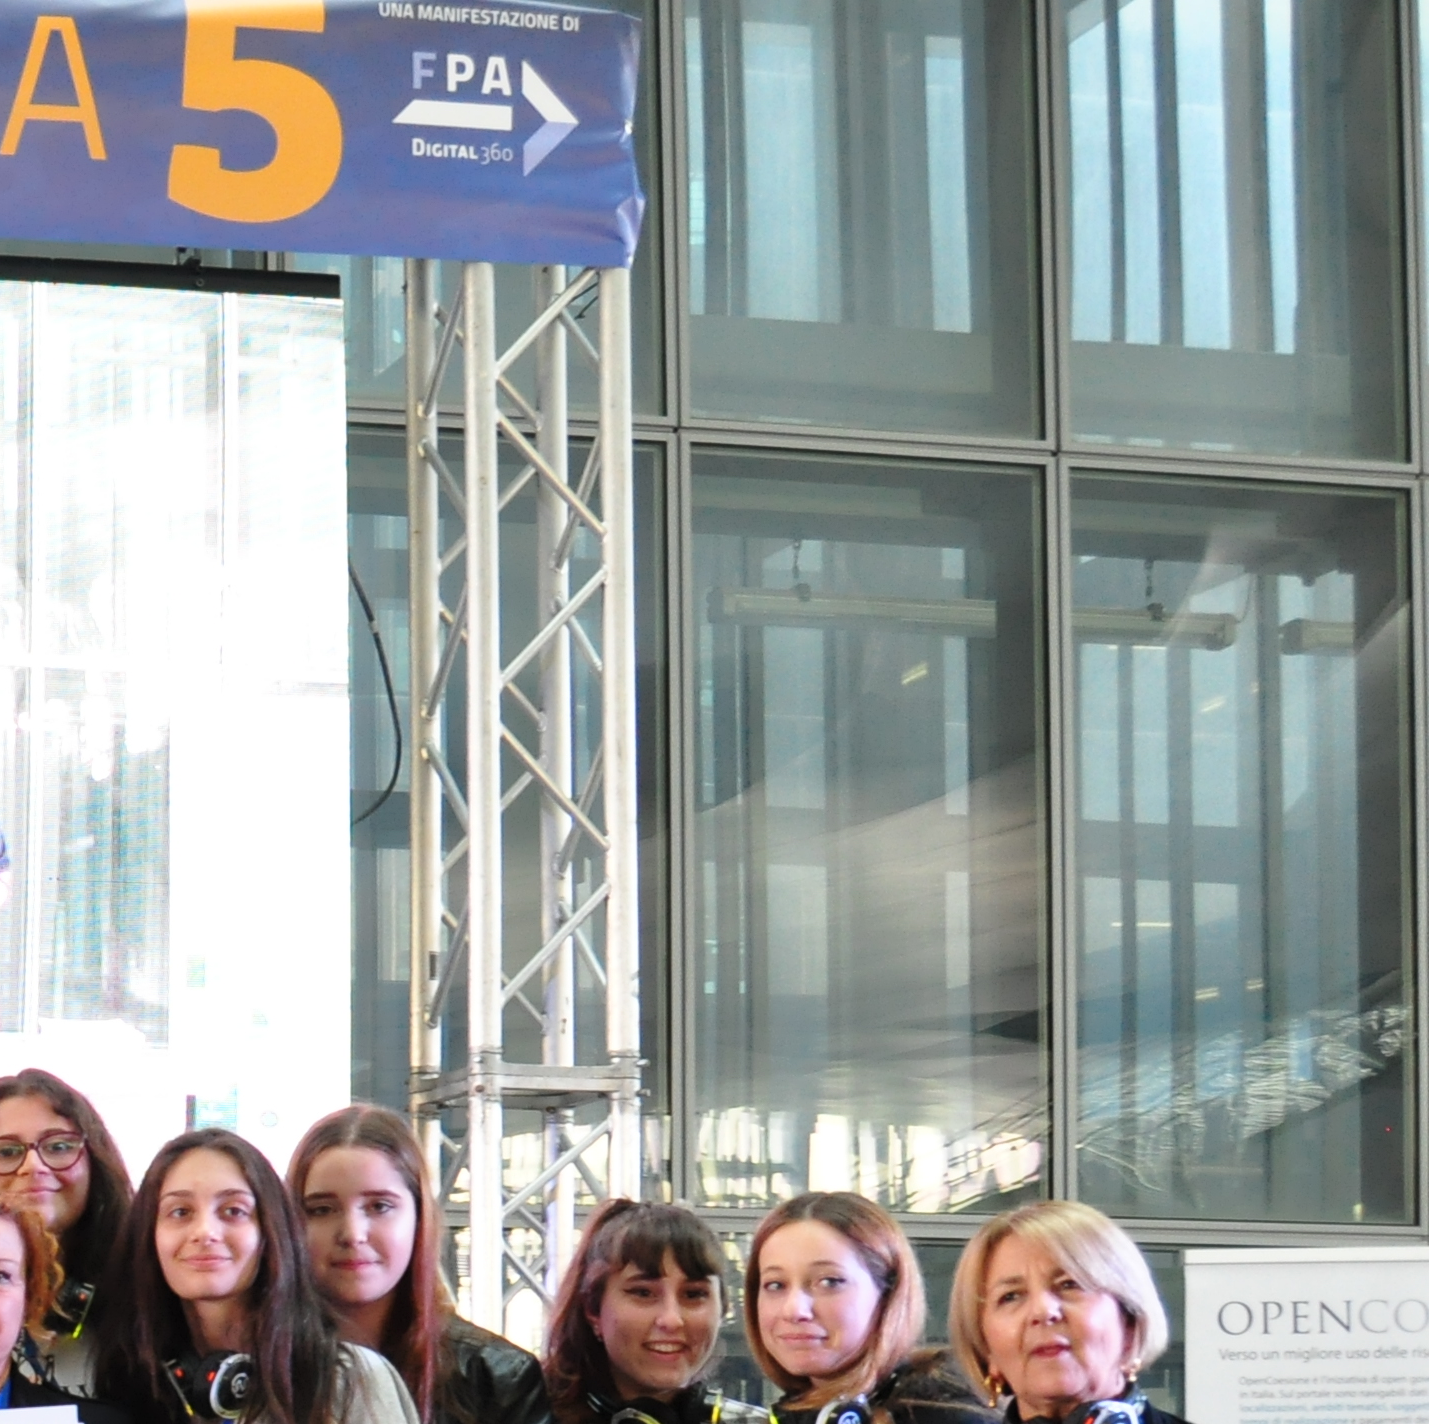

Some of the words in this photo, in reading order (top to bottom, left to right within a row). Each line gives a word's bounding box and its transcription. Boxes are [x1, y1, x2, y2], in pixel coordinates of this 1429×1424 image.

[378, 2, 414, 20] UNA
[417, 5, 559, 30] MANIFESTAZIONE
[562, 17, 579, 32] DI
[412, 51, 513, 97] FPA
[168, 0, 343, 223] 5
[1219, 1348, 1259, 1361] Verso
[1262, 1350, 1280, 1361] un
[1283, 1347, 1342, 1364] migliore
[1346, 1350, 1370, 1361] uso
[1373, 1346, 1409, 1361] delle
